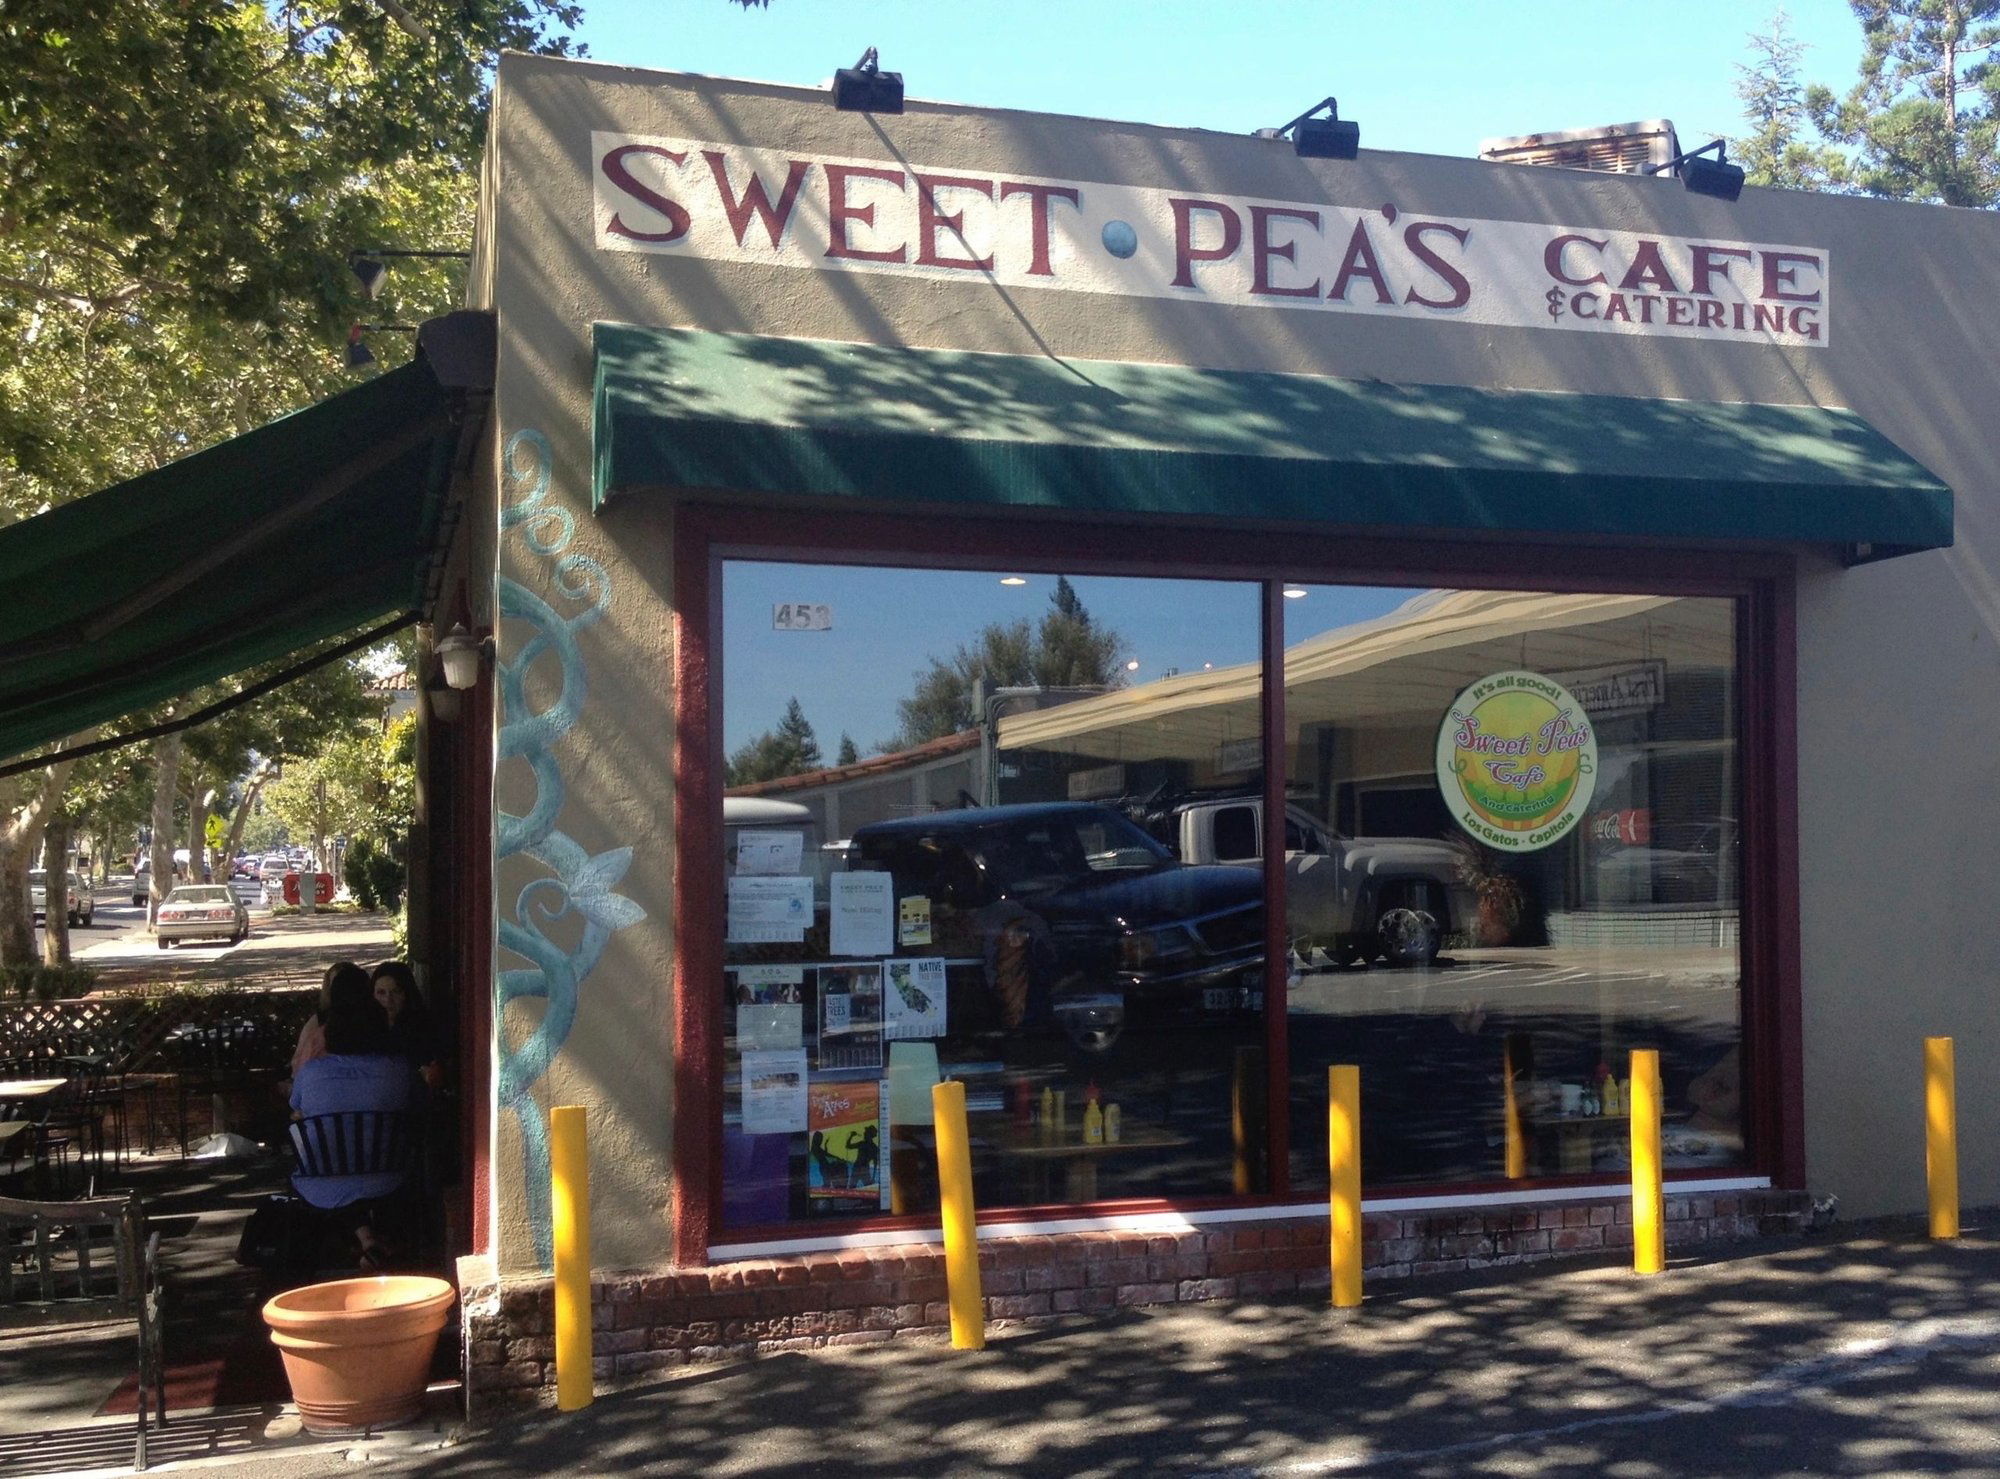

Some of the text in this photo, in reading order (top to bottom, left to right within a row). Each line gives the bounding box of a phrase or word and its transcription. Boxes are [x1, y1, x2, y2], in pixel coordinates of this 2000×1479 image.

[601, 144, 1471, 309] SWEET PEA'S
[1544, 234, 1821, 303] CAFE
[1472, 676, 1562, 700] It's all good!
[1450, 708, 1590, 757] Sweet Pea's
[1483, 760, 1546, 791] Cafe
[1462, 812, 1482, 833] Los
[1481, 827, 1519, 846] Gatos
[1529, 811, 1575, 844] Capitola
